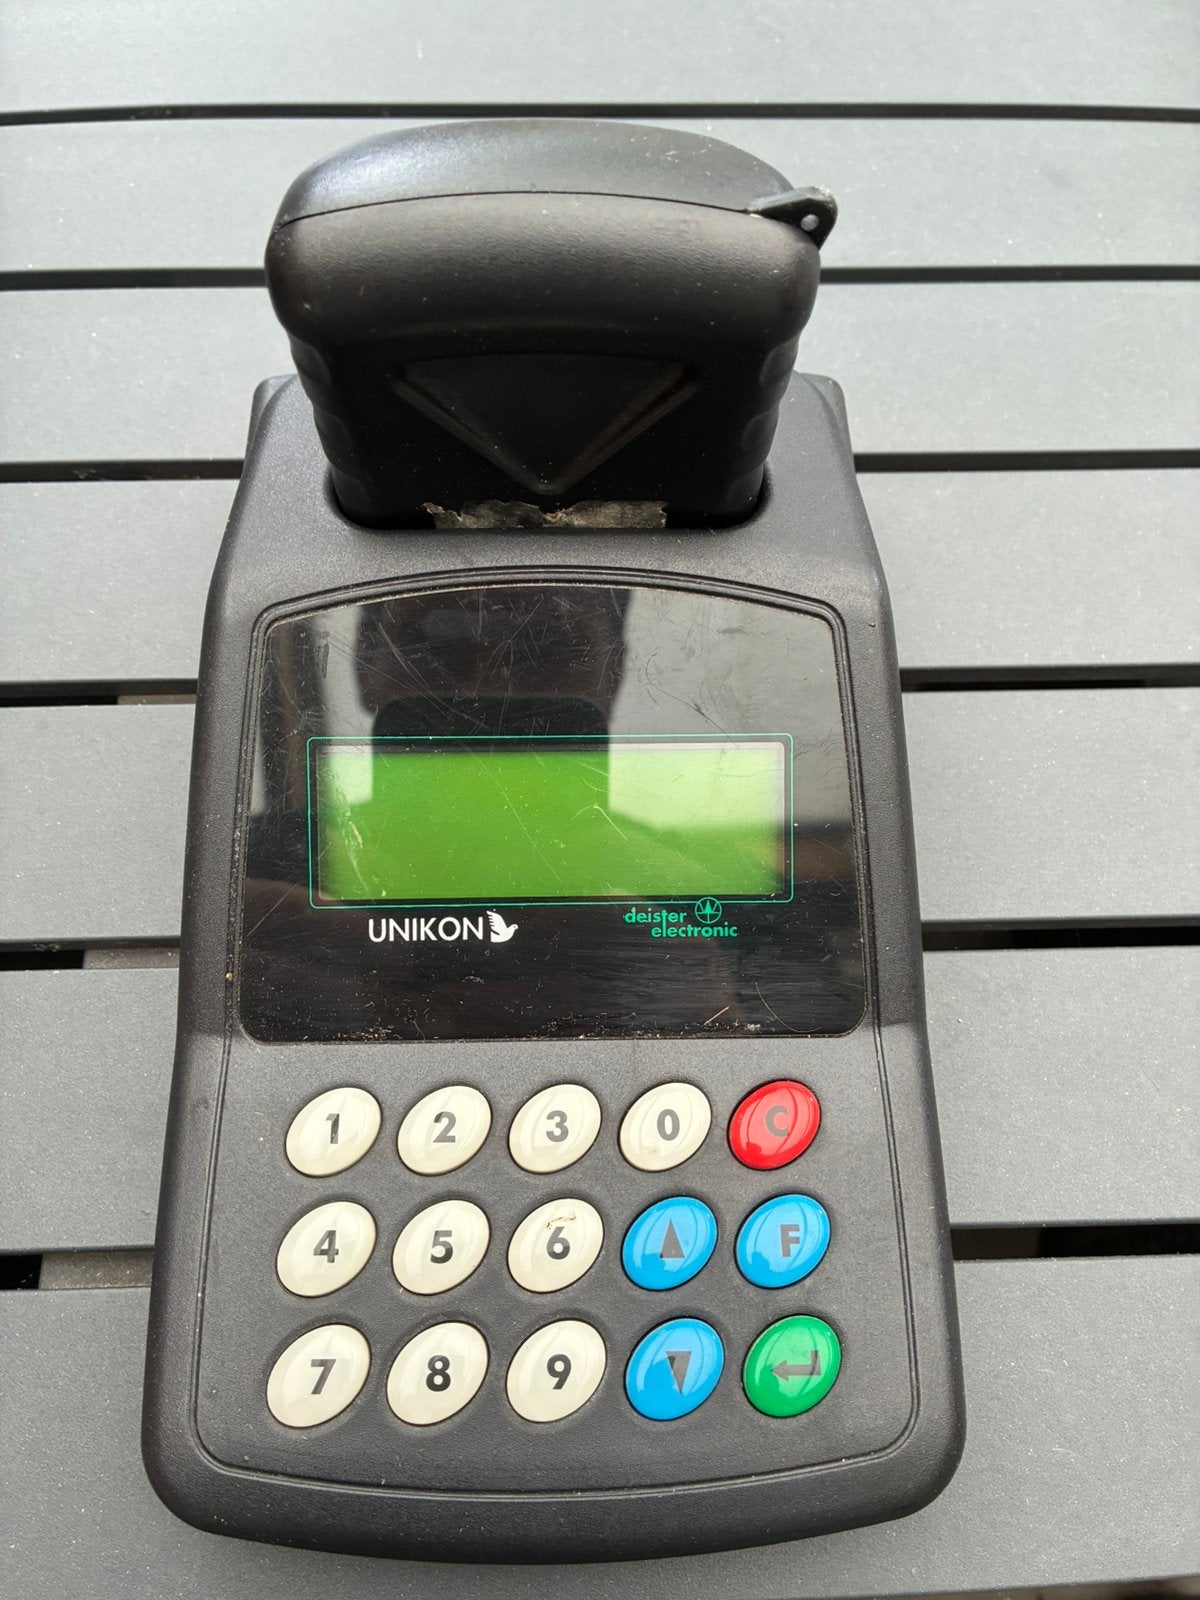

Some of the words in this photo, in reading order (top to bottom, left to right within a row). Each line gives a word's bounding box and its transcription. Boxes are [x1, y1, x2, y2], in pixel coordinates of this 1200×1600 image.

[367, 915, 484, 943] UNIKON
[623, 906, 687, 924] deister
[650, 923, 739, 939] electronic
[324, 1112, 341, 1145] 1
[432, 1110, 457, 1143] 2
[545, 1109, 570, 1142] 3
[656, 1108, 681, 1141] 0
[764, 1105, 790, 1137] C
[312, 1229, 340, 1263] 4
[429, 1230, 454, 1264] 5
[546, 1226, 571, 1260] 6
[779, 1223, 801, 1257] F
[309, 1358, 337, 1395] 7
[425, 1354, 452, 1392] 8
[546, 1353, 573, 1390] 9
